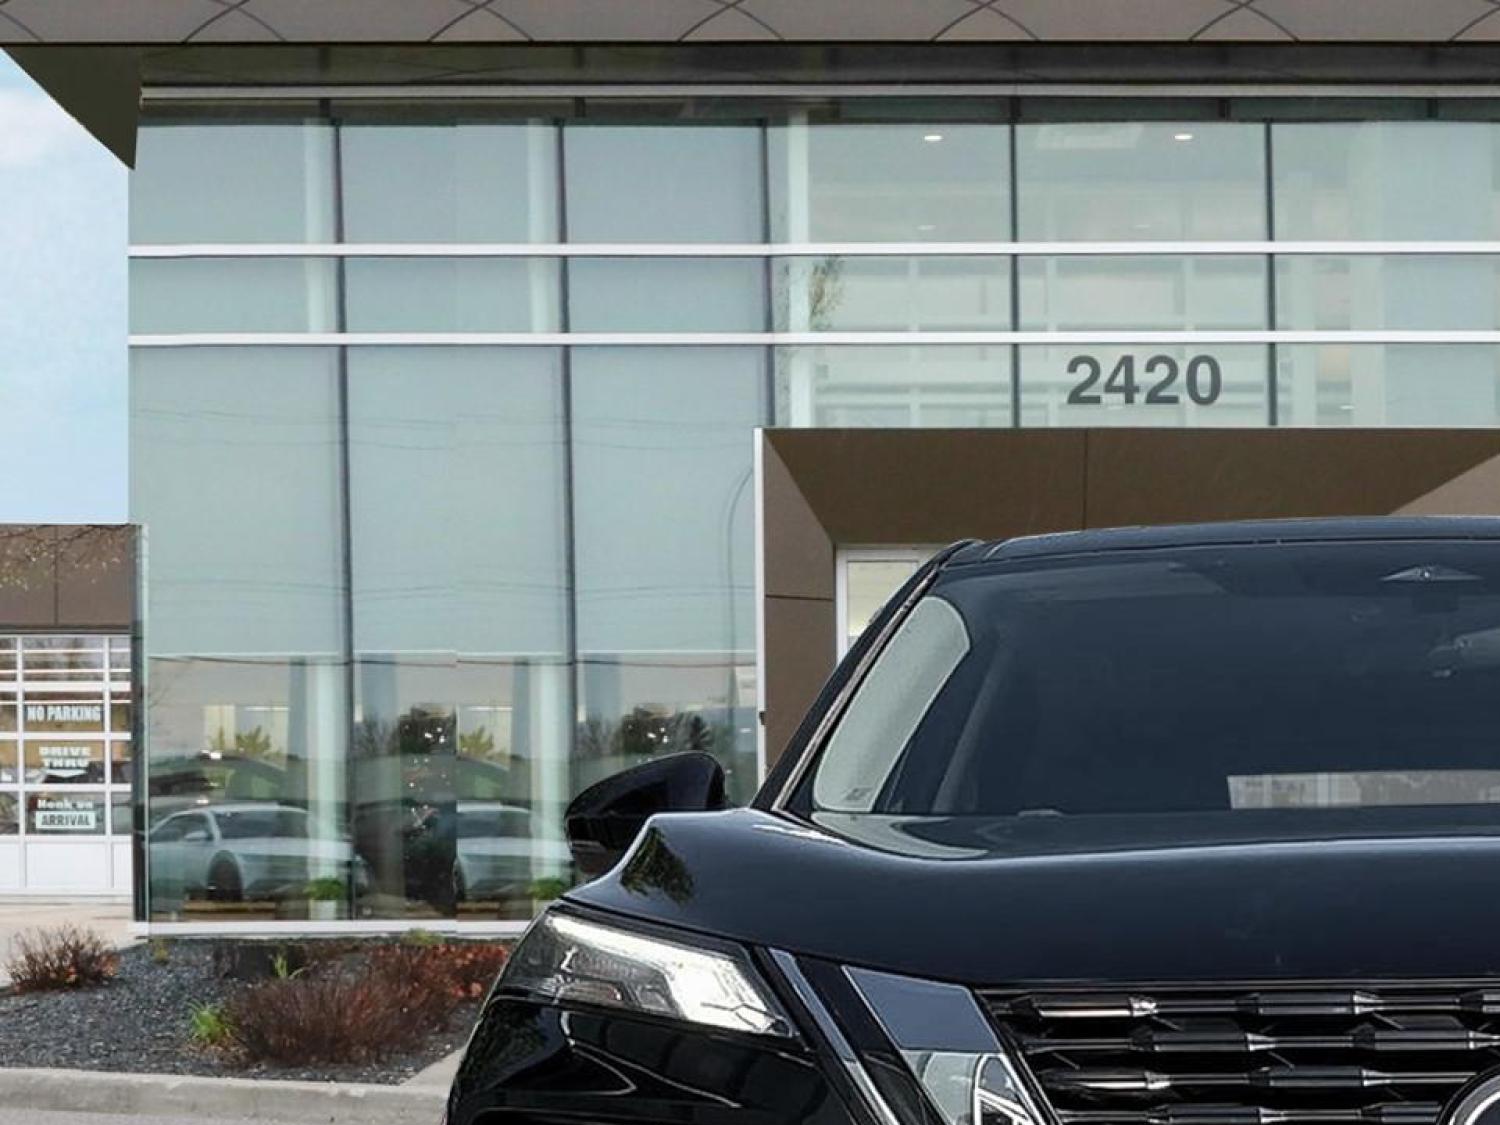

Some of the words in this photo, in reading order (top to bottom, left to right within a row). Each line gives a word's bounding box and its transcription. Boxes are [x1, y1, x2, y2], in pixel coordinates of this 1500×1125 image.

[1066, 354, 1222, 406] 2420
[27, 705, 45, 721] NO
[47, 705, 100, 721] PARKING
[39, 746, 91, 756] DRIVE
[44, 758, 89, 768] THRU
[41, 814, 90, 826] ARRIVAL
